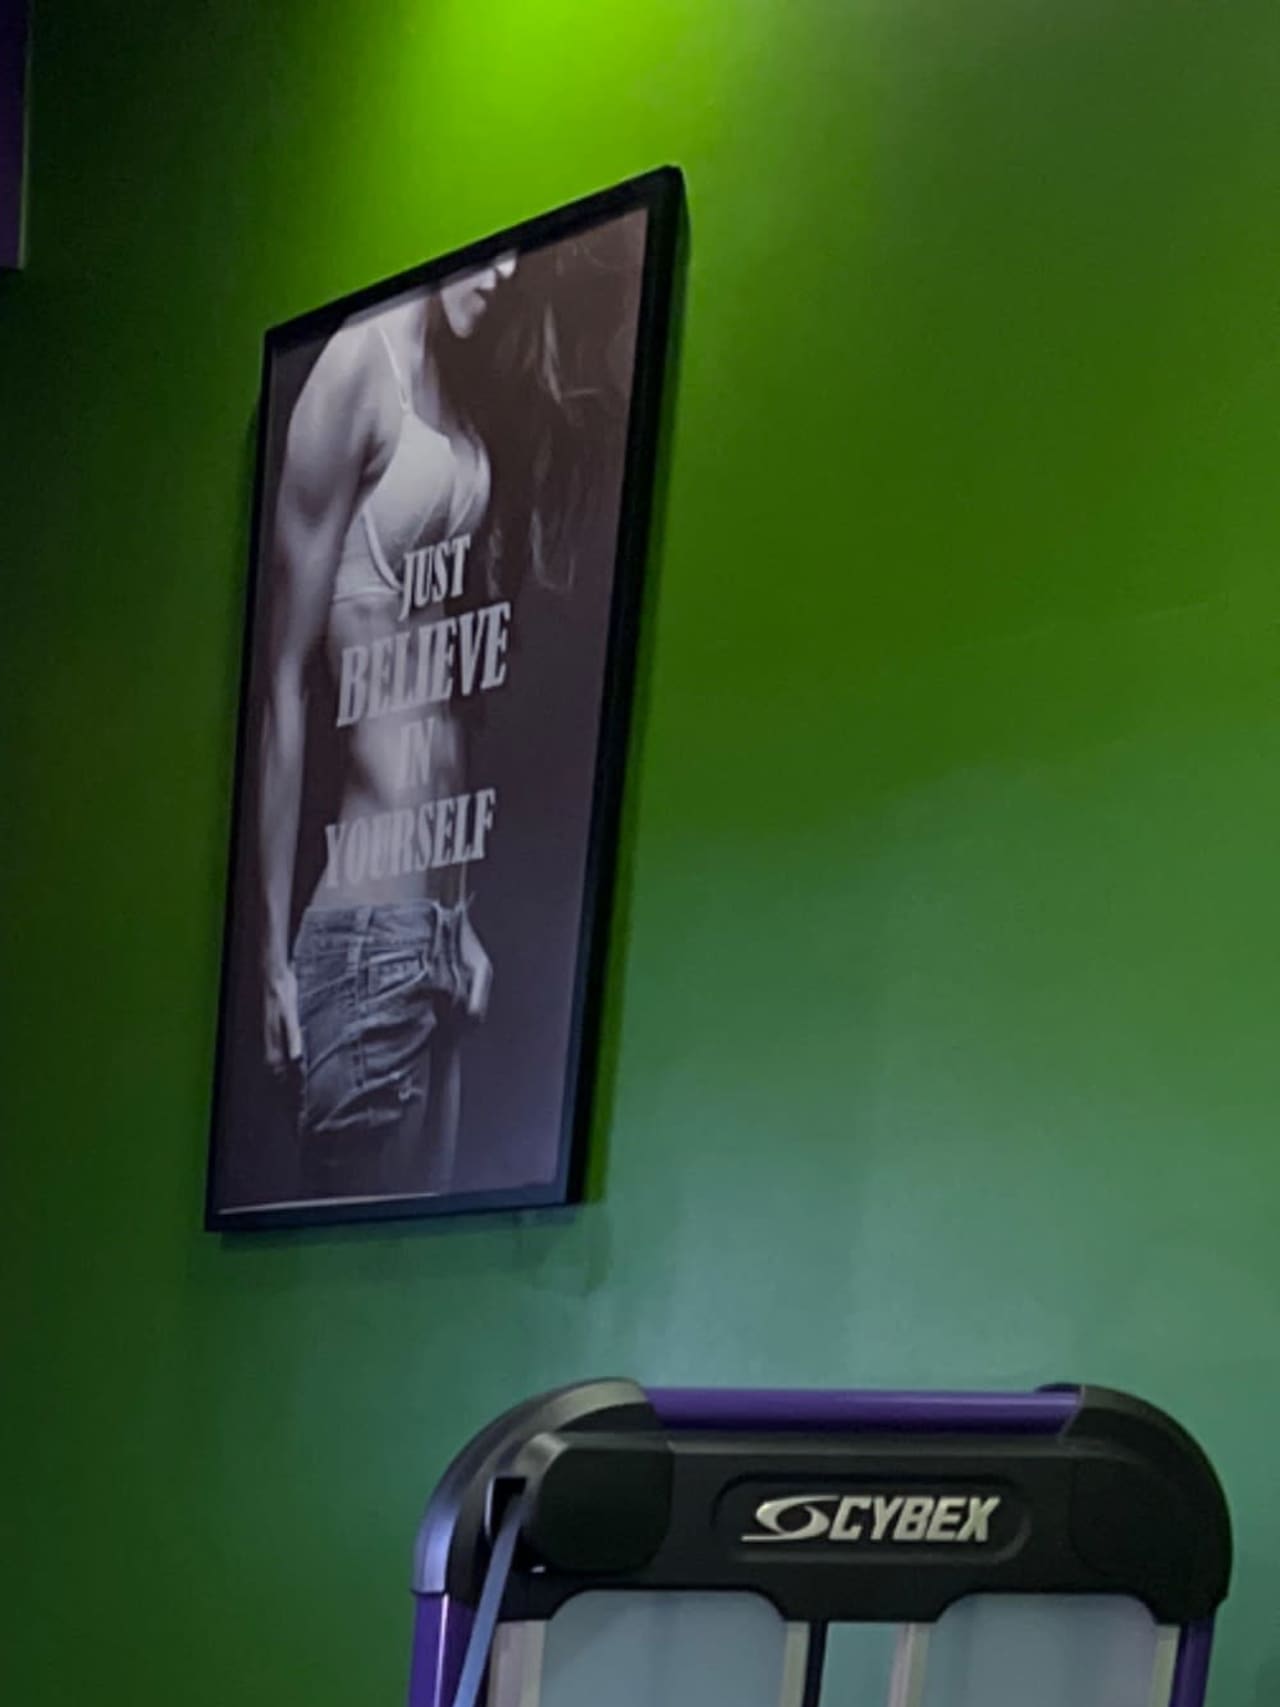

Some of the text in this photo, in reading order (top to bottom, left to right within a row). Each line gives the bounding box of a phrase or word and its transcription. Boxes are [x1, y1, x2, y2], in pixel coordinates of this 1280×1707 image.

[398, 534, 471, 622] JUST
[336, 602, 511, 727] BELIEVE
[397, 717, 436, 792] IN
[324, 788, 496, 888] YOURSELF
[828, 1494, 1002, 1543] CYBEX
